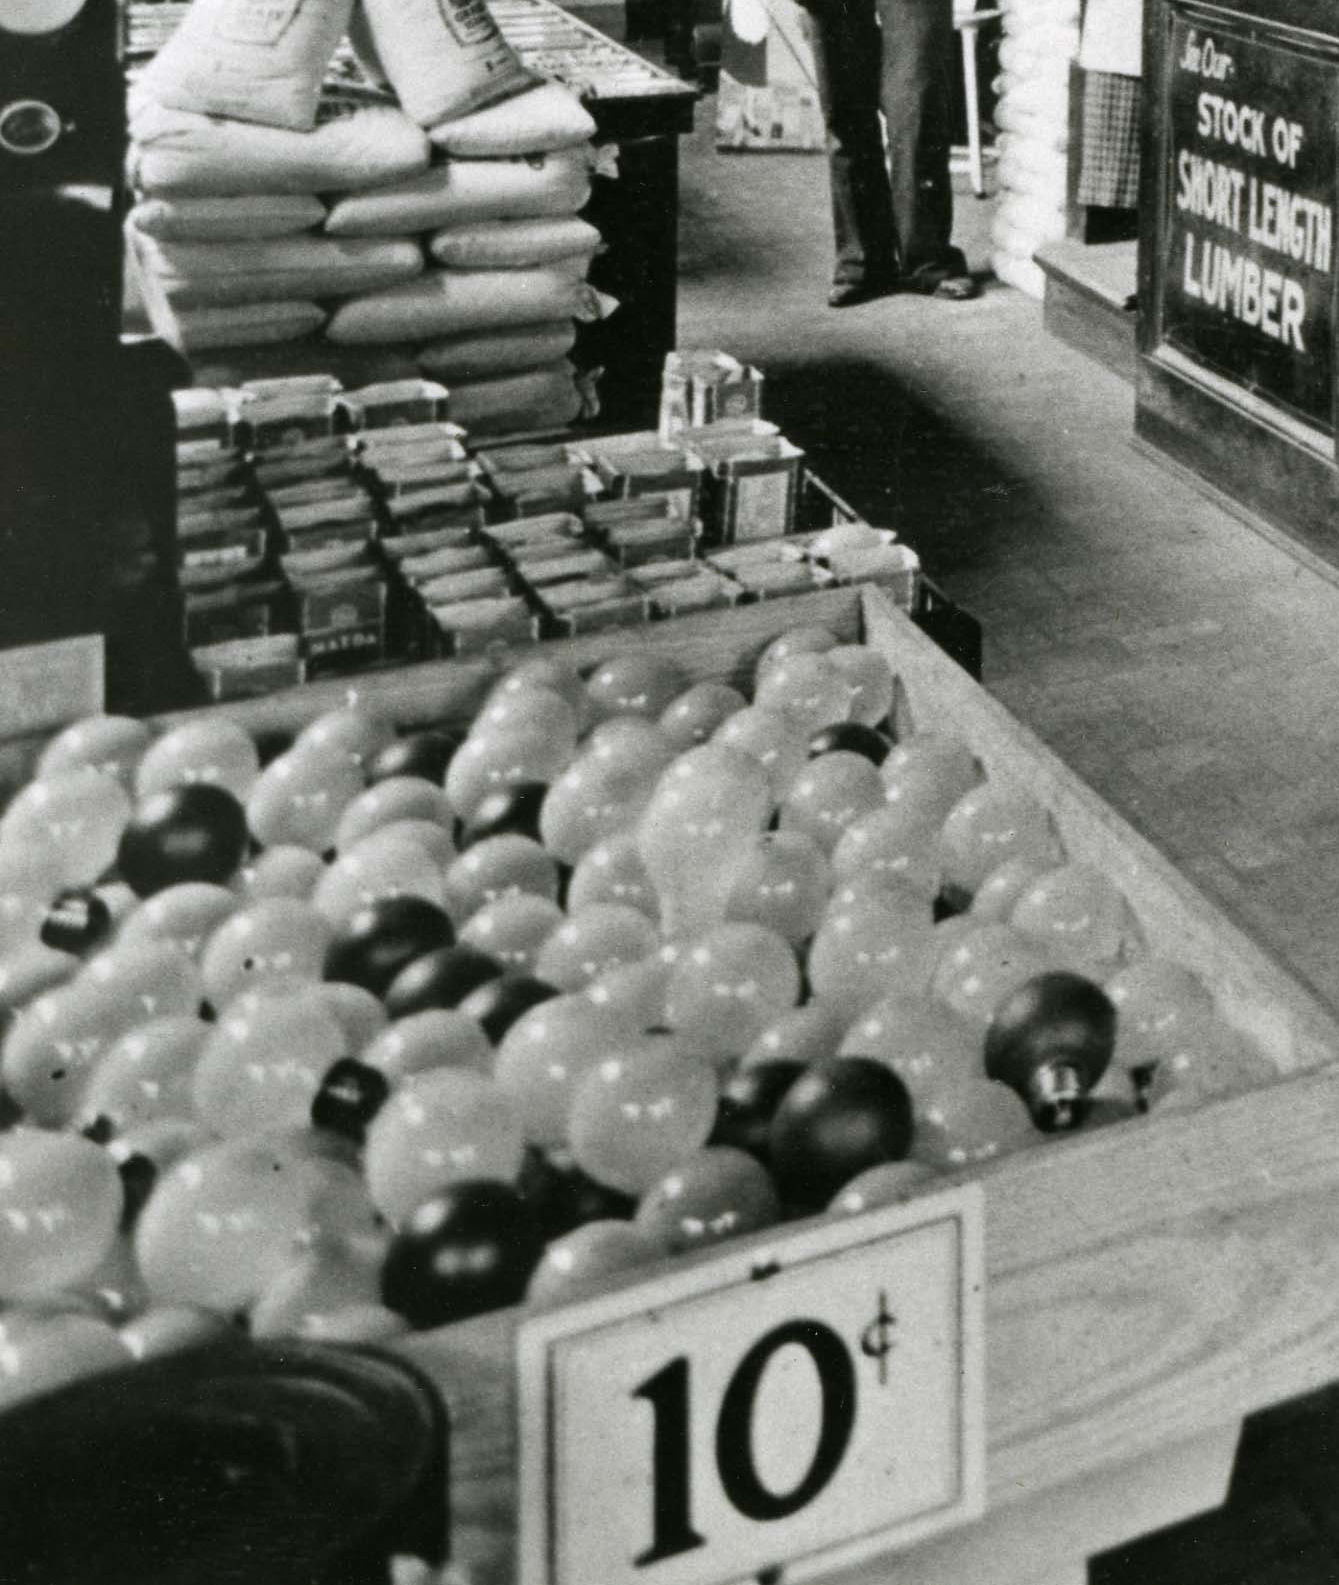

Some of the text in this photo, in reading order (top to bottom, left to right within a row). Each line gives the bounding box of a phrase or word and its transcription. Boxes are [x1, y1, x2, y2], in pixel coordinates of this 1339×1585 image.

[1198, 92, 1303, 170] STOCK OF
[1177, 149, 1333, 274] SHORT LENGTH
[1183, 231, 1308, 353] LUMBER
